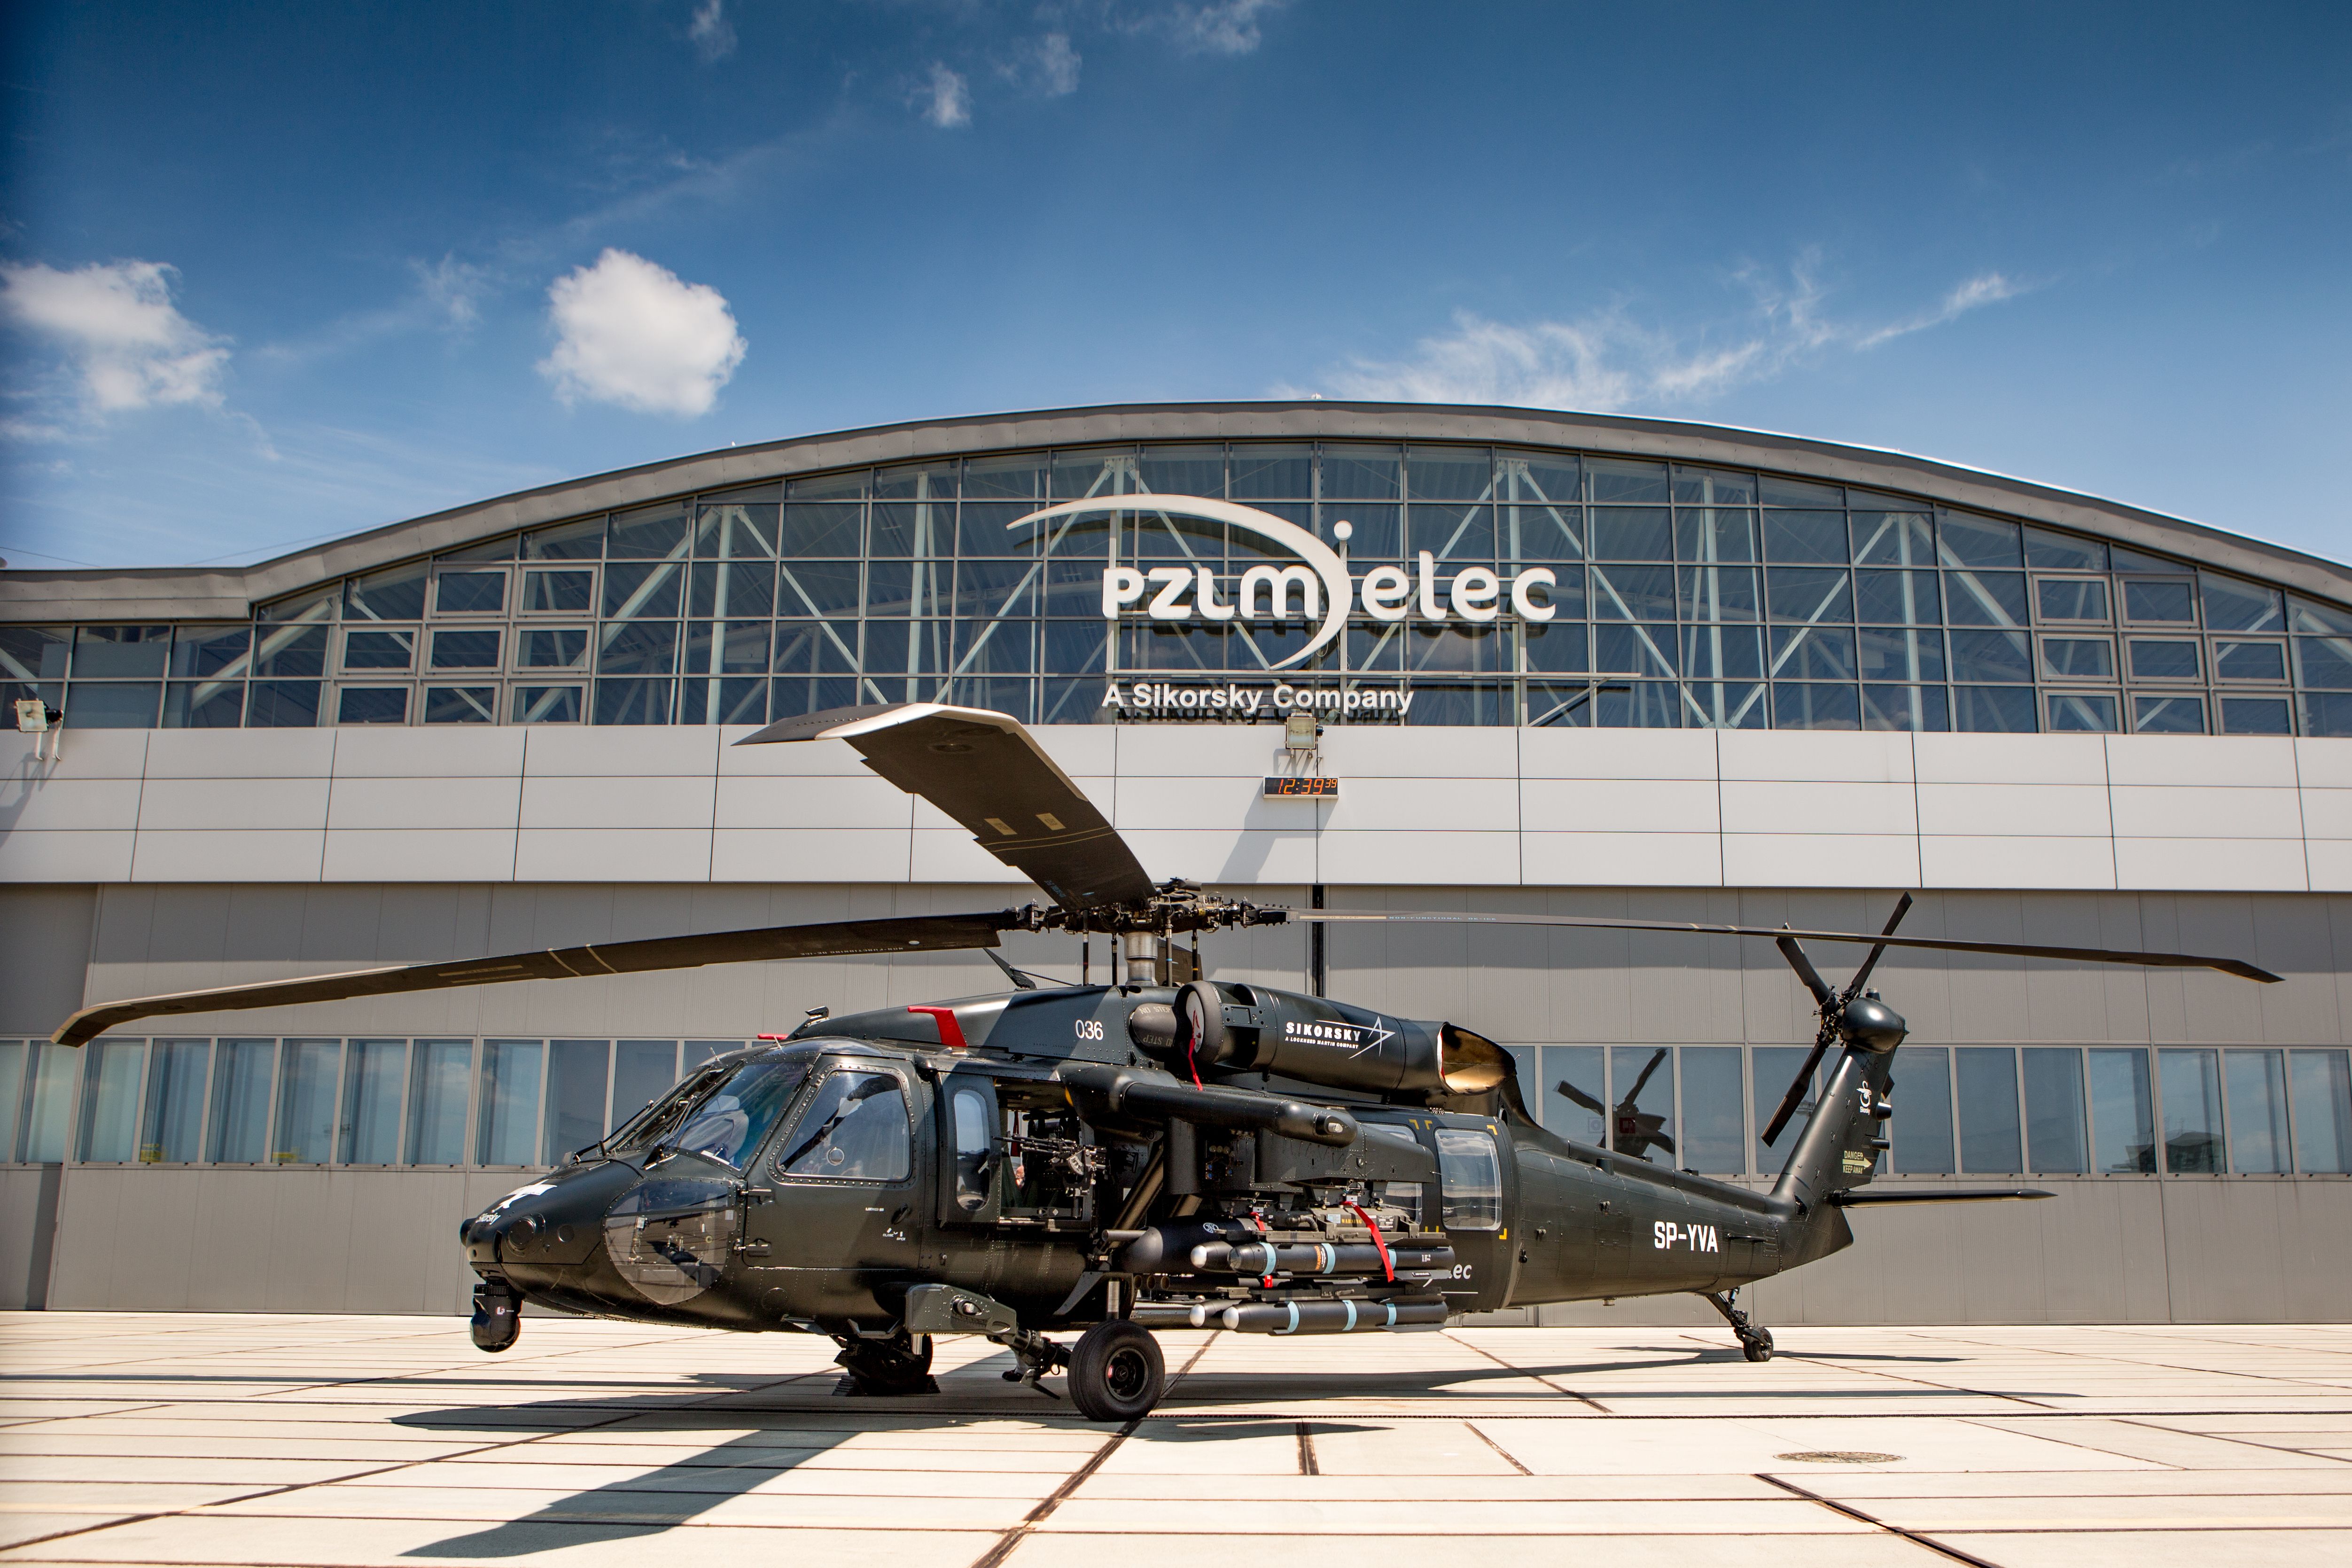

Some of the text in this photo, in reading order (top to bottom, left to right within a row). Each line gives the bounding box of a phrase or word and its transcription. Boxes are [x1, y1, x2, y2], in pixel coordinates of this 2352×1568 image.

[1102, 684, 1414, 716] A Sikorsky Company
[1278, 779, 1324, 794] 12:39
[1075, 1019, 1104, 1040] 036
[1285, 1022, 1361, 1041] SIKORSKY
[1844, 1150, 1863, 1160] DANGER
[1843, 1165, 1853, 1173] KEEP
[1654, 1221, 1718, 1253] SP-YVA
